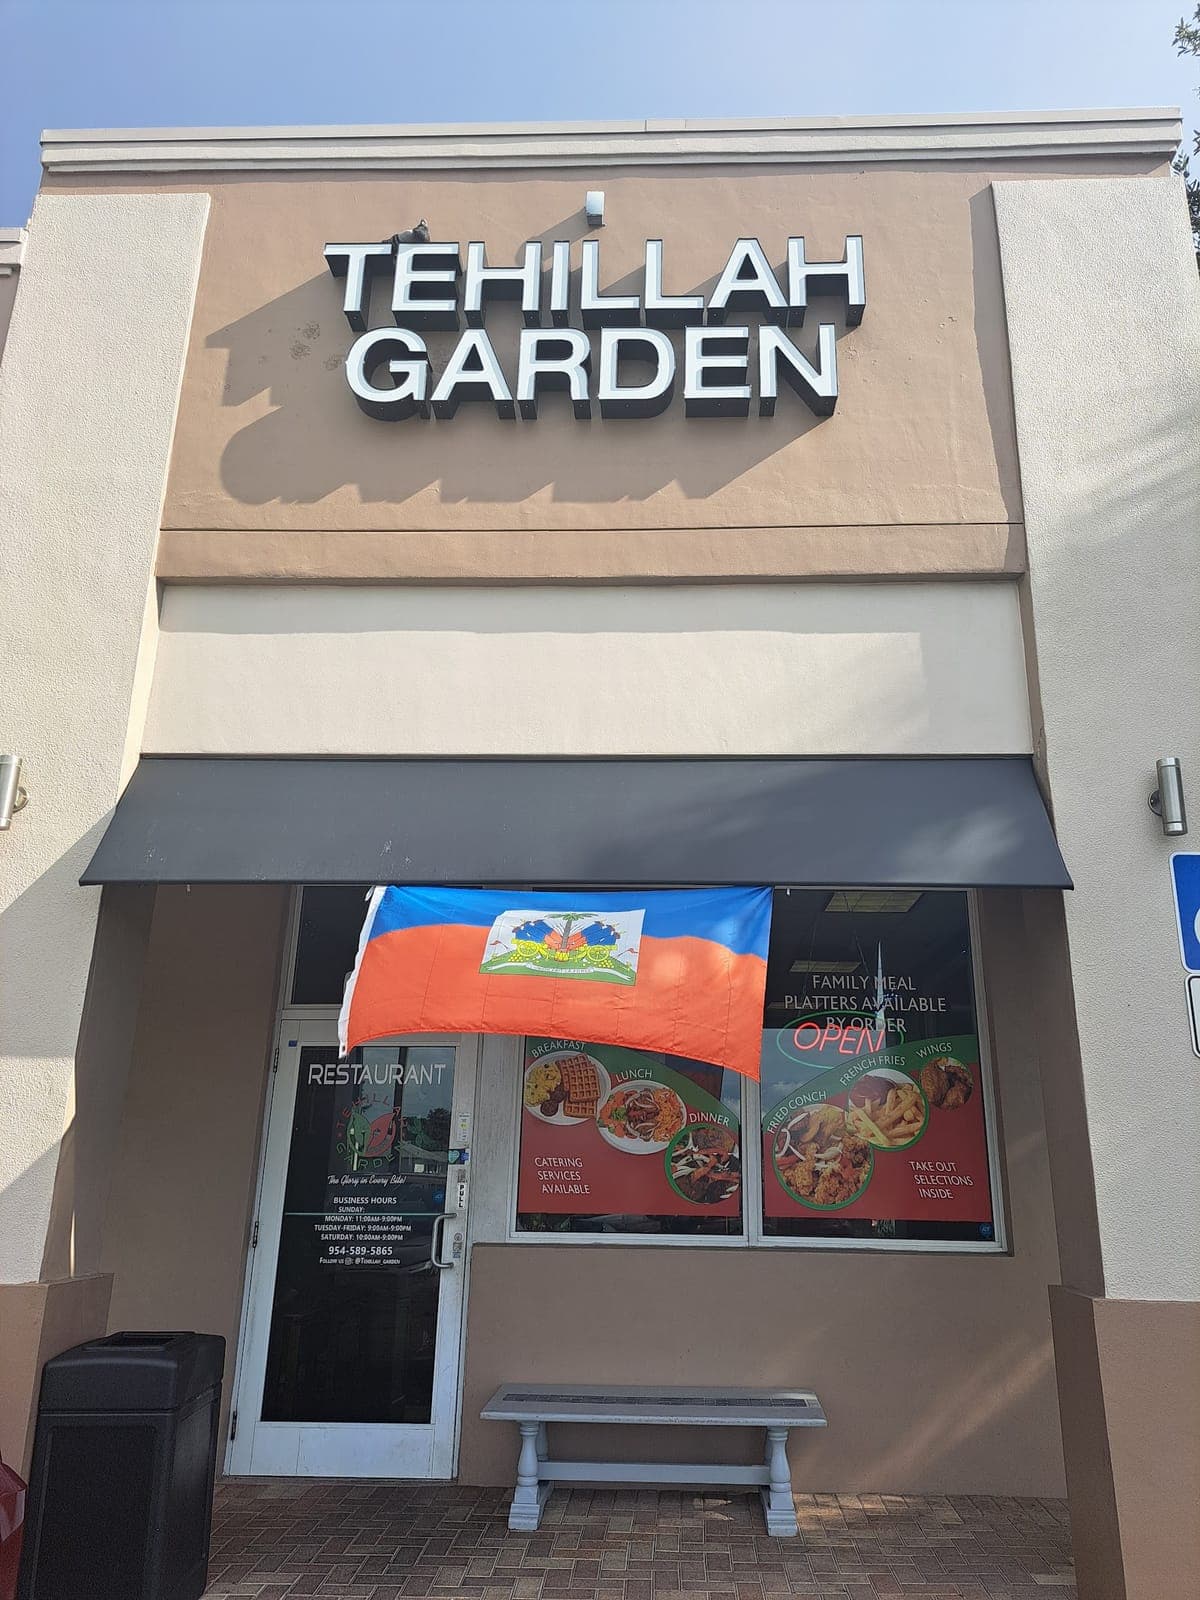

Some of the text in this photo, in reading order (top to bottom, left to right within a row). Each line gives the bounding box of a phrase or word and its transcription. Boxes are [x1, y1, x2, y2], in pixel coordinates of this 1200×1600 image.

[324, 235, 866, 322] TEHILLAH
[345, 323, 839, 412] GARDEN
[812, 975, 916, 991] FAMILY MEAL
[784, 995, 947, 1012] PLATTERS AVAILABLE
[826, 1016, 907, 1033] BY ORDER
[793, 1022, 885, 1055] OPEN
[531, 1040, 586, 1058] BREAKFAST
[916, 1043, 953, 1058] WINGS
[308, 1063, 446, 1085] RESTAURANT
[615, 1068, 653, 1082] LUNCH
[839, 1055, 906, 1087] FRENCH FRIES
[689, 1112, 730, 1126] DINNER
[767, 1091, 827, 1134] FRIED CONCH
[534, 1157, 583, 1168] CATERING
[909, 1161, 957, 1172] TAKE OUT
[327, 1174, 339, 1184] The
[341, 1174, 358, 1187] Glory
[360, 1175, 367, 1184] in
[537, 1171, 581, 1181] SERVICES
[914, 1175, 974, 1186] SELECTIONS
[541, 1184, 591, 1194] AVAILABLE
[919, 1188, 954, 1199] INSIDE
[333, 1196, 369, 1204] BUSINESS
[320, 1233, 355, 1241] SATURDAY:
[328, 1246, 393, 1255] 954-589-5865
